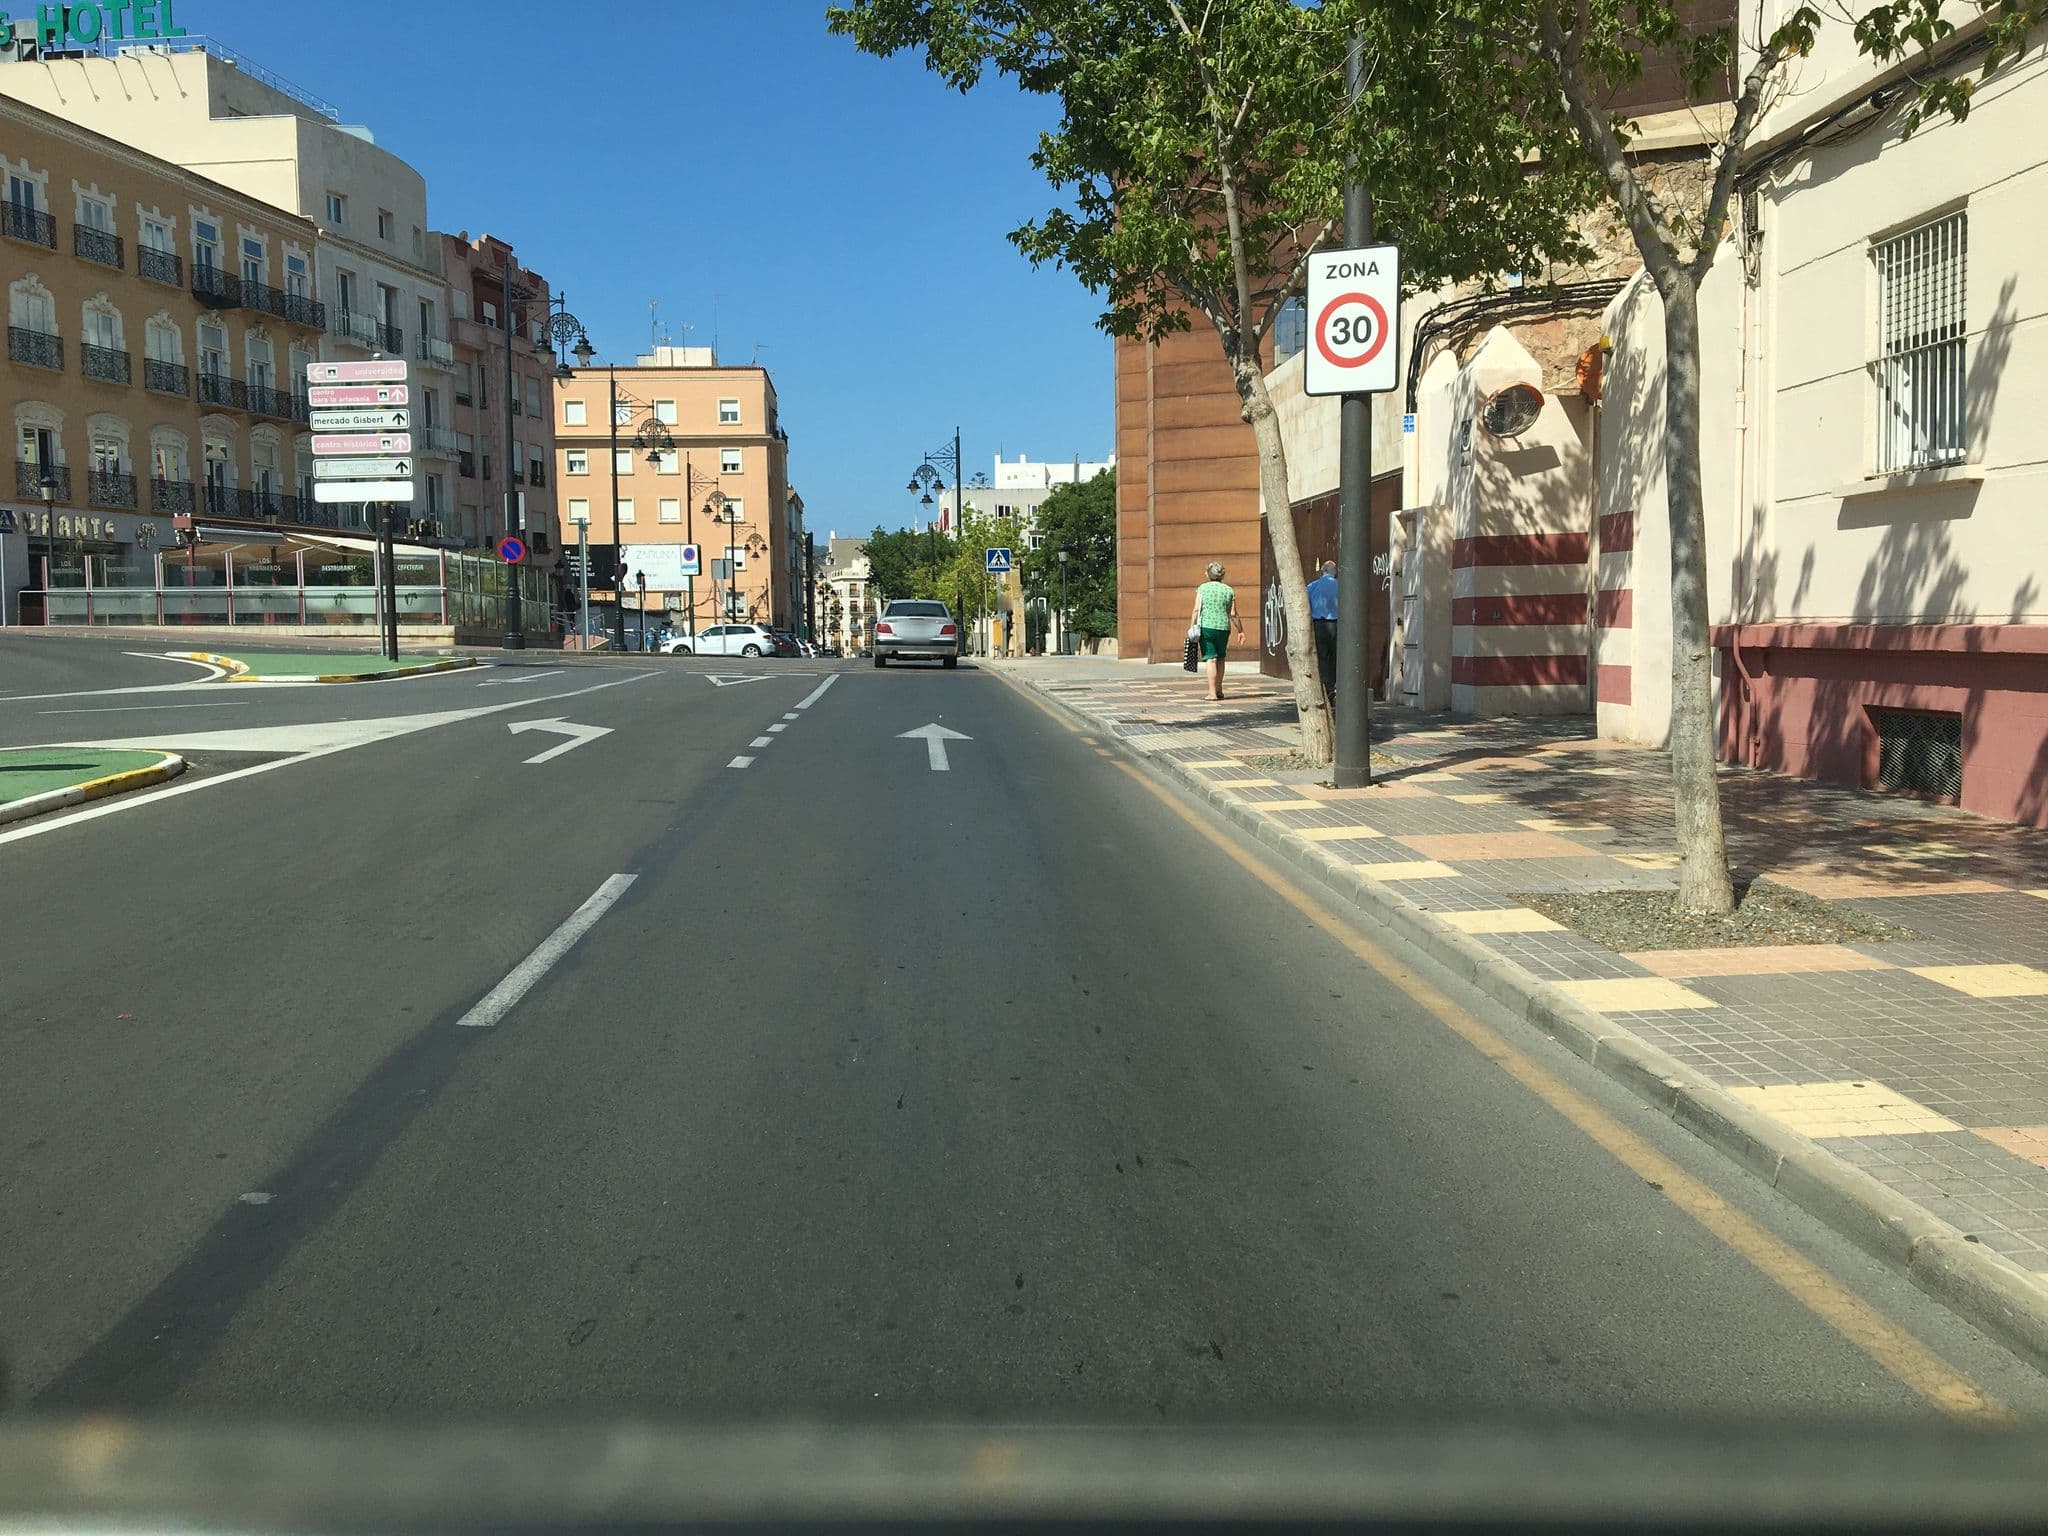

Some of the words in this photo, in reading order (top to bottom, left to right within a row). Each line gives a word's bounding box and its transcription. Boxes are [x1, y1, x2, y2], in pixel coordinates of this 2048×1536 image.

[36, 0, 186, 46] HOTEL
[1325, 261, 1379, 279] ZONA
[1332, 316, 1372, 345] 30
[354, 366, 403, 376] universidad
[314, 417, 350, 425] mercado
[353, 416, 384, 424] Gisbert
[315, 441, 342, 449] centro
